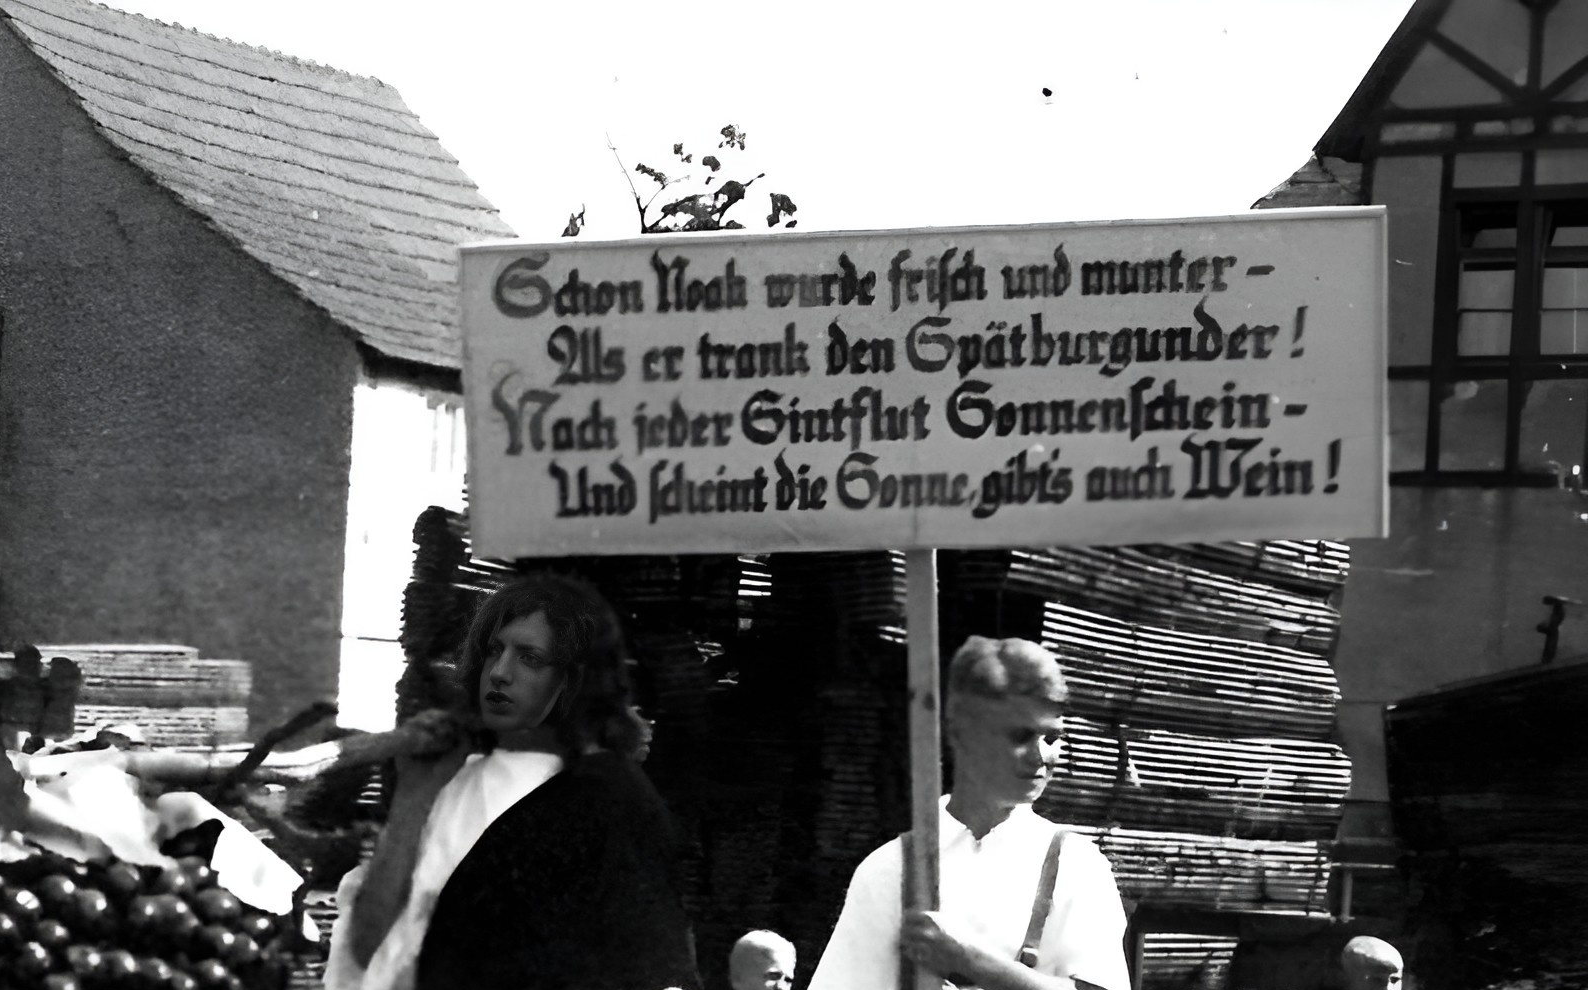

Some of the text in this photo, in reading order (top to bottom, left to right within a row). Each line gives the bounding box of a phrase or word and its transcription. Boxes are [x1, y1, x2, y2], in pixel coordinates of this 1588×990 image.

[492, 250, 643, 318] Schon
[764, 250, 876, 308] wurde
[1001, 242, 1072, 299] und
[547, 324, 627, 386] Als
[641, 345, 686, 381] er
[697, 321, 811, 379] trank
[826, 315, 895, 376] den
[491, 366, 618, 456] Nach
[633, 394, 734, 453] jeder
[740, 385, 931, 452] Sintflut
[548, 455, 638, 518] Und
[774, 447, 828, 512] die
[1085, 445, 1175, 501] auch
